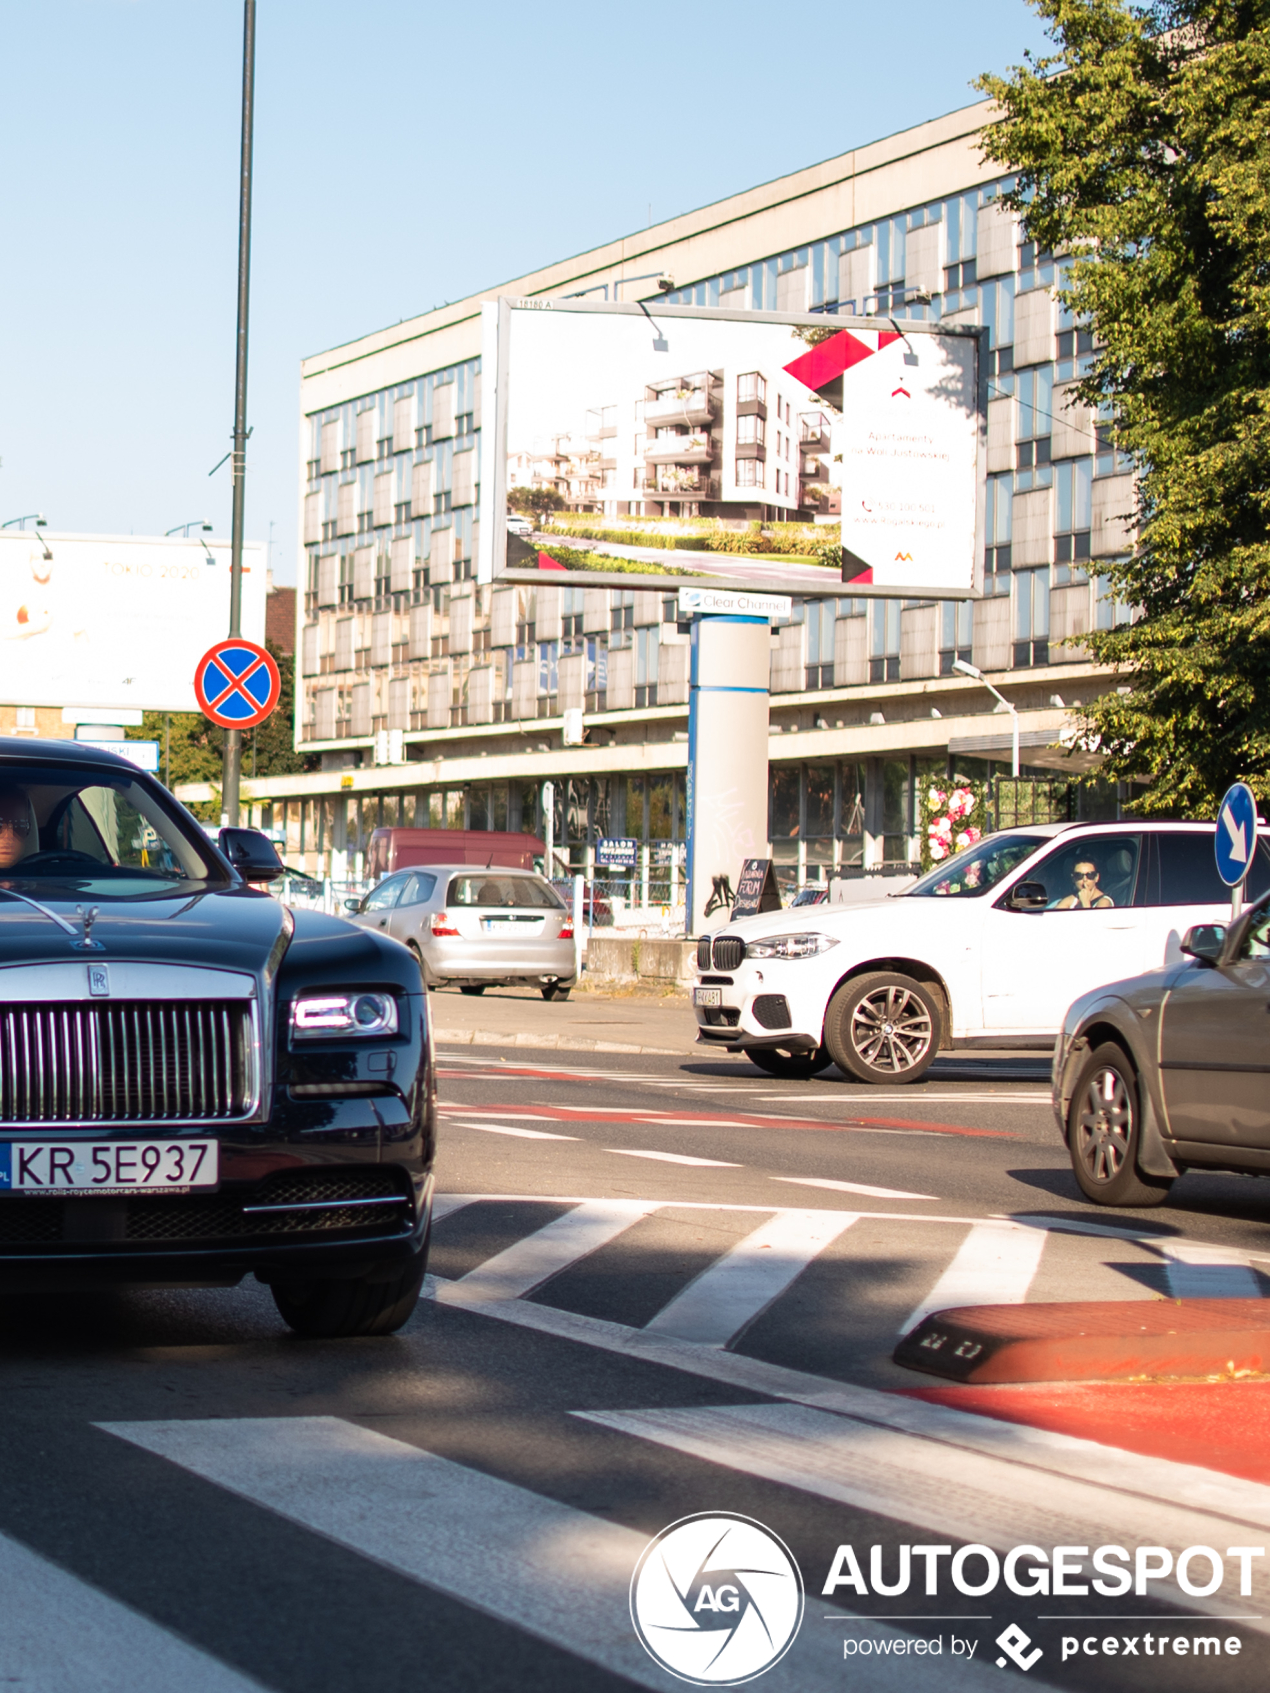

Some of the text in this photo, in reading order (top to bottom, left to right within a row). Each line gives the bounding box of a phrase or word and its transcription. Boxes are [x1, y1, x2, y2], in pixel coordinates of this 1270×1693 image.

[545, 301, 552, 309] A
[868, 431, 934, 444] Apartamenty
[851, 447, 950, 462] na Woli Justowskiej
[899, 503, 917, 511] 100
[103, 562, 200, 580] TOKIO 2020
[703, 595, 786, 611] Clear Channel
[602, 840, 633, 848] SALON
[739, 880, 761, 895] FORUM
[17, 1144, 209, 1185] KR 5E937
[24, 1186, 190, 1197] www.rolls-roycemotorcars-warszawa.pl
